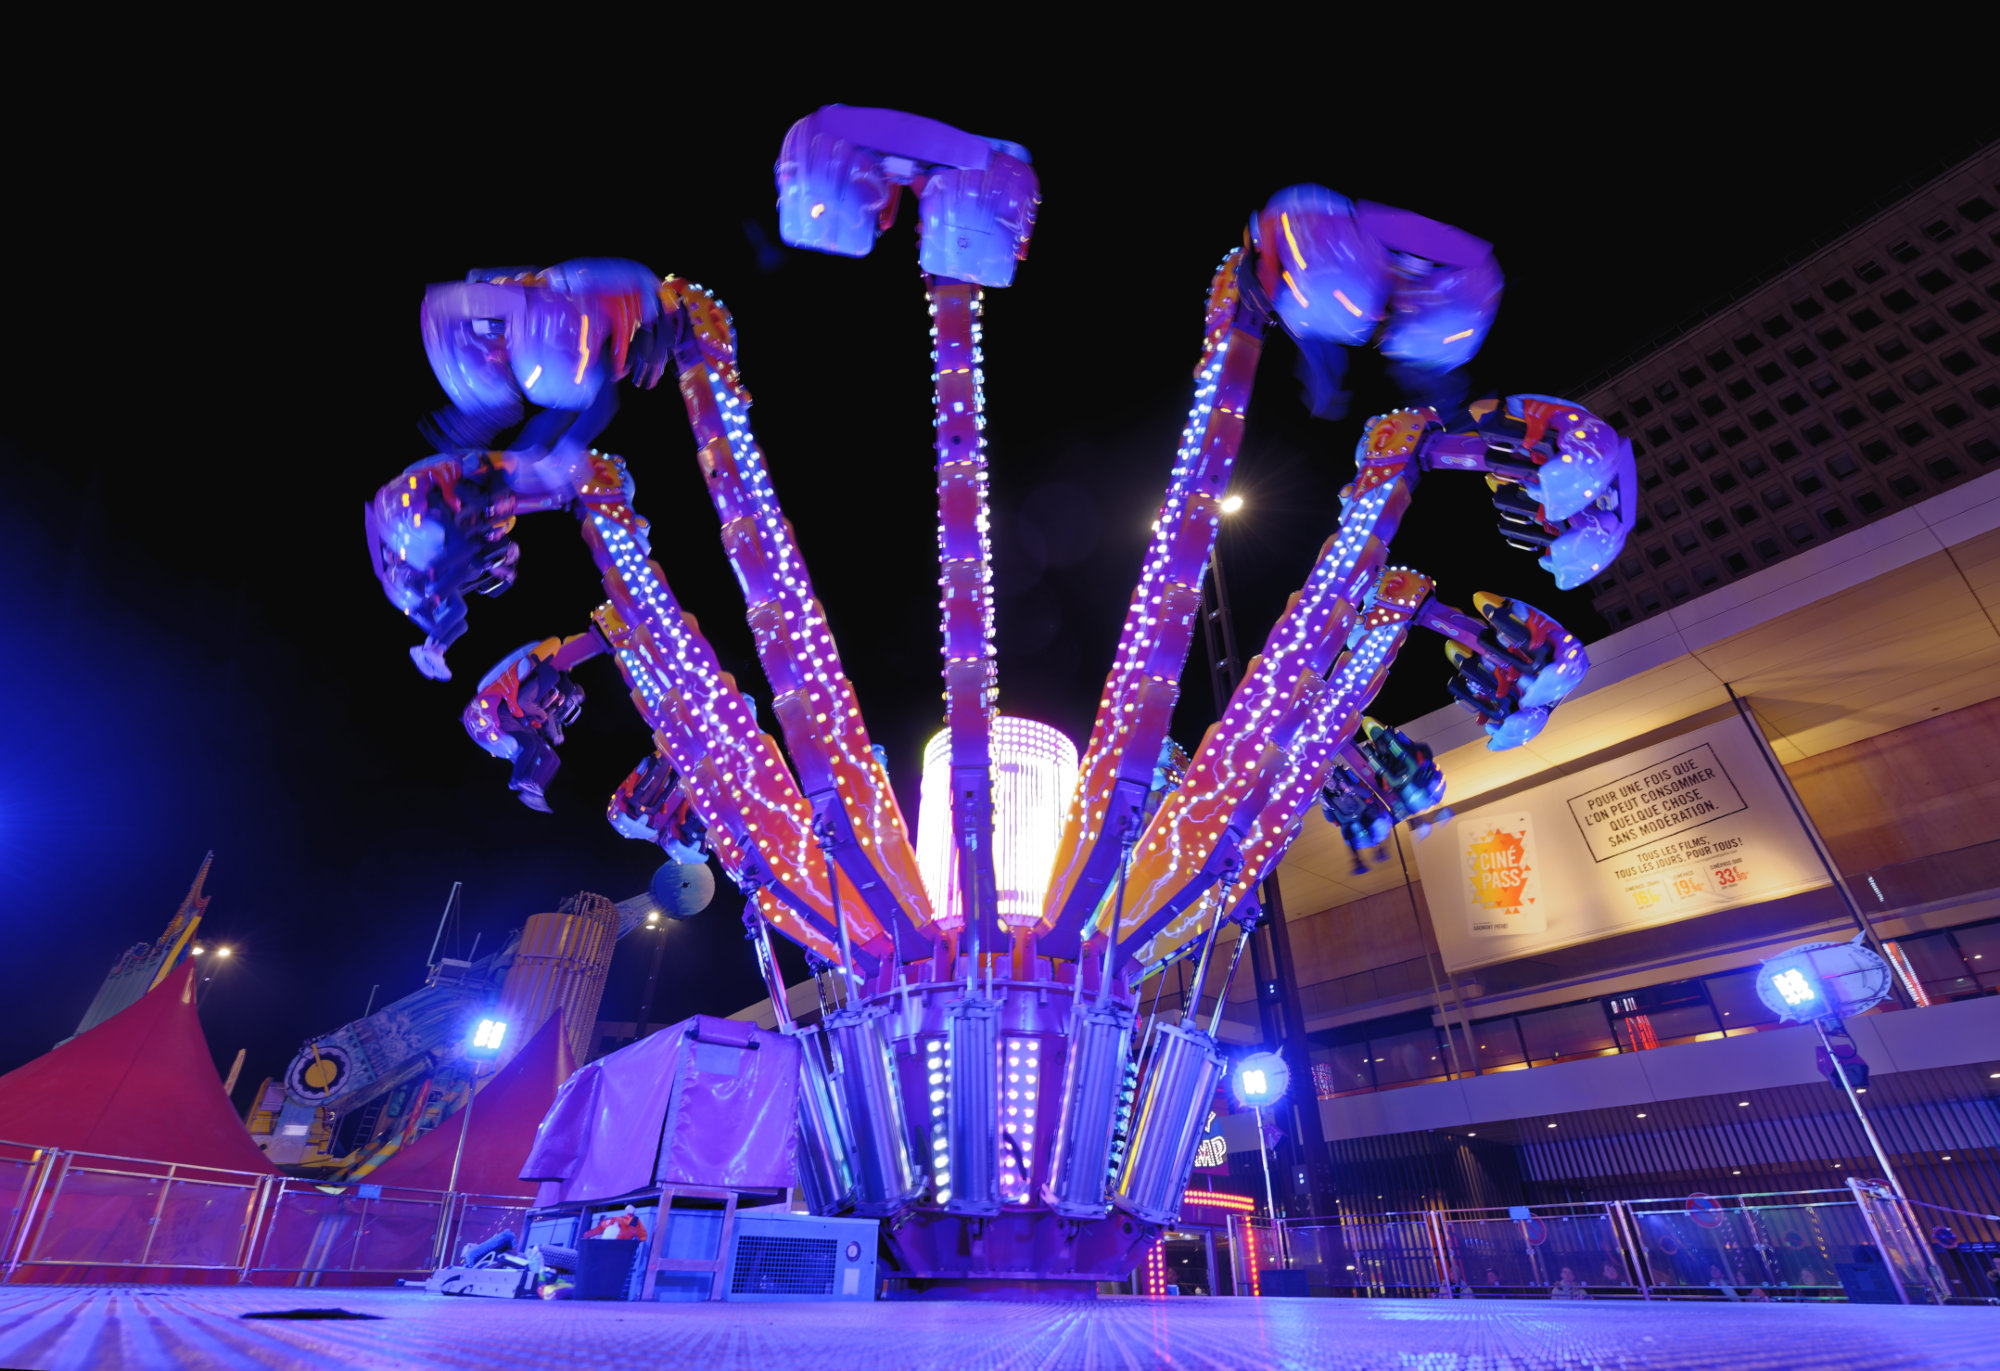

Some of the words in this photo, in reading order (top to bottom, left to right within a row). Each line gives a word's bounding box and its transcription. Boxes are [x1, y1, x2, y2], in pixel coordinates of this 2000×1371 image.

[1584, 810, 1610, 826] L'ON
[1610, 797, 1638, 817] PEUT
[1640, 767, 1716, 805] CONSOMMER
[1587, 790, 1618, 811] POUR
[1619, 781, 1643, 798] UNE
[1644, 769, 1672, 789] FOIS
[1672, 758, 1698, 776] QUE
[1608, 828, 1638, 848] SANS
[1639, 800, 1720, 837] MODÉRATION.
[1609, 804, 1661, 832] QUELQUE
[1662, 788, 1704, 812] CHOSE
[1480, 844, 1519, 871] CINÉ
[1614, 866, 1638, 880] TOUS
[1638, 861, 1654, 874] LES
[1686, 846, 1712, 860] POUR
[1637, 849, 1660, 863] TOUS
[1661, 844, 1678, 856] LES
[1482, 868, 1521, 889] PASS
[1194, 1135, 1227, 1167] MP
